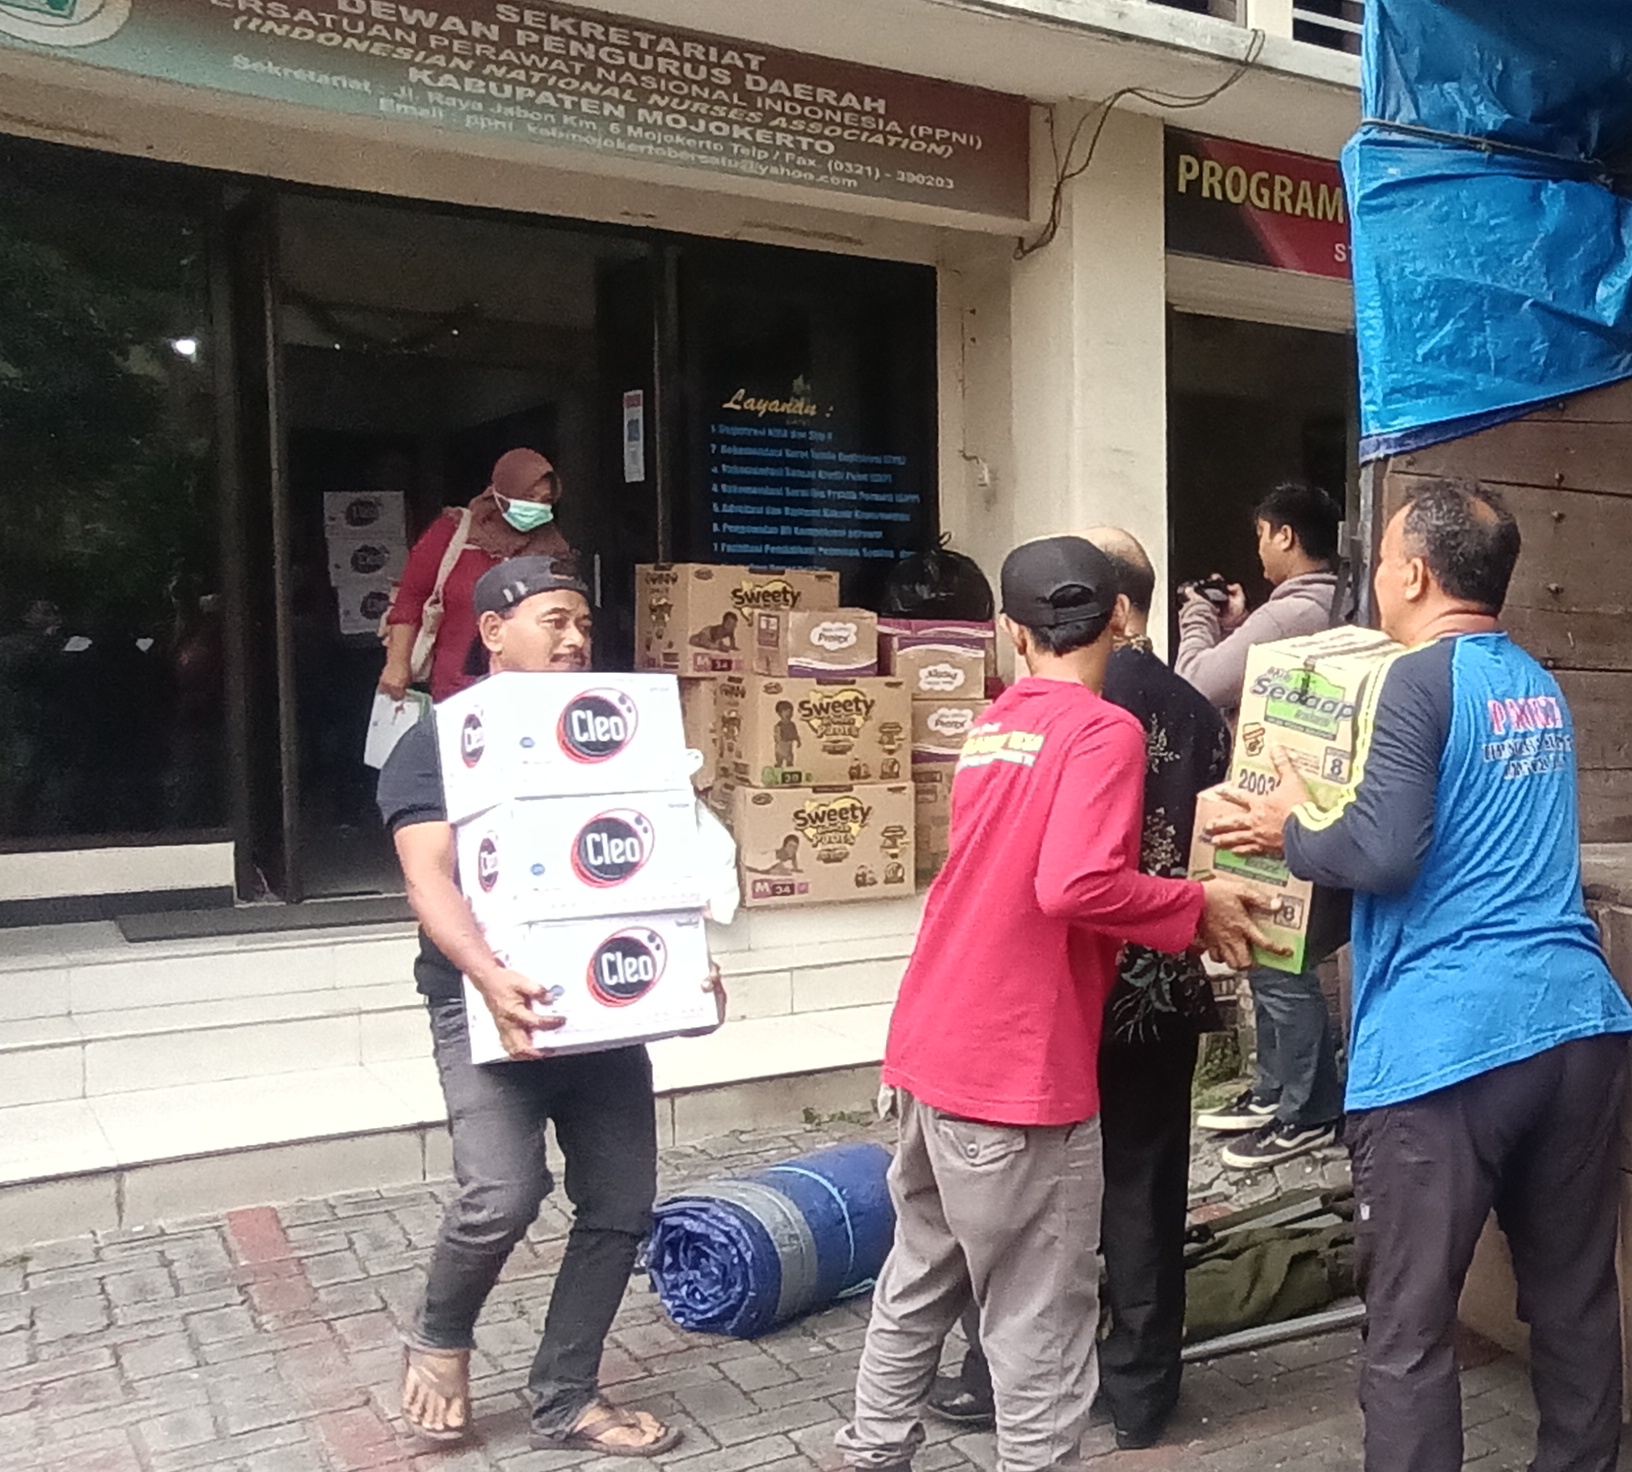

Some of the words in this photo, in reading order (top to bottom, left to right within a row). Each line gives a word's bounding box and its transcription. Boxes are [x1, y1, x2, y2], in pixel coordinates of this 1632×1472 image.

[496, 3, 766, 72] SEKRETARIAT
[210, 0, 417, 46] RSATUAN
[429, 34, 586, 77] PERAWAT
[597, 66, 748, 106] NASIONAL
[757, 96, 904, 135] INDONESIA
[910, 125, 983, 151] (PPNI)
[338, 0, 500, 42] DEWAN
[516, 28, 732, 86] PENGURUS
[744, 73, 887, 116] DAERAH
[232, 16, 475, 72] (INDONESIAN
[482, 64, 638, 103] NATIONAL
[648, 93, 764, 124] NURSES
[769, 116, 954, 159] ASSOCIATION)
[231, 53, 373, 95] Sekretariat
[427, 90, 484, 113] Raya
[489, 103, 556, 124] Jabon
[609, 122, 621, 135] 6
[627, 124, 724, 152] Mojokerto
[731, 142, 770, 161] Telp
[827, 159, 881, 182] (0321)
[408, 66, 626, 119] KABUPATEN
[638, 108, 836, 155] MOJOKERTO
[1177, 154, 1346, 225] PROGRAM
[722, 388, 818, 418] Layanan
[730, 585, 803, 610] Sweety
[797, 695, 876, 719] Sweety
[1251, 677, 1357, 722] Sedaap
[570, 709, 627, 744] Cleo
[1238, 768, 1282, 796] 200
[1329, 758, 1343, 776] 8
[793, 802, 874, 827] Sweety
[585, 832, 641, 867] Cleo
[1282, 905, 1296, 922] 8
[601, 951, 655, 987] Cleo
